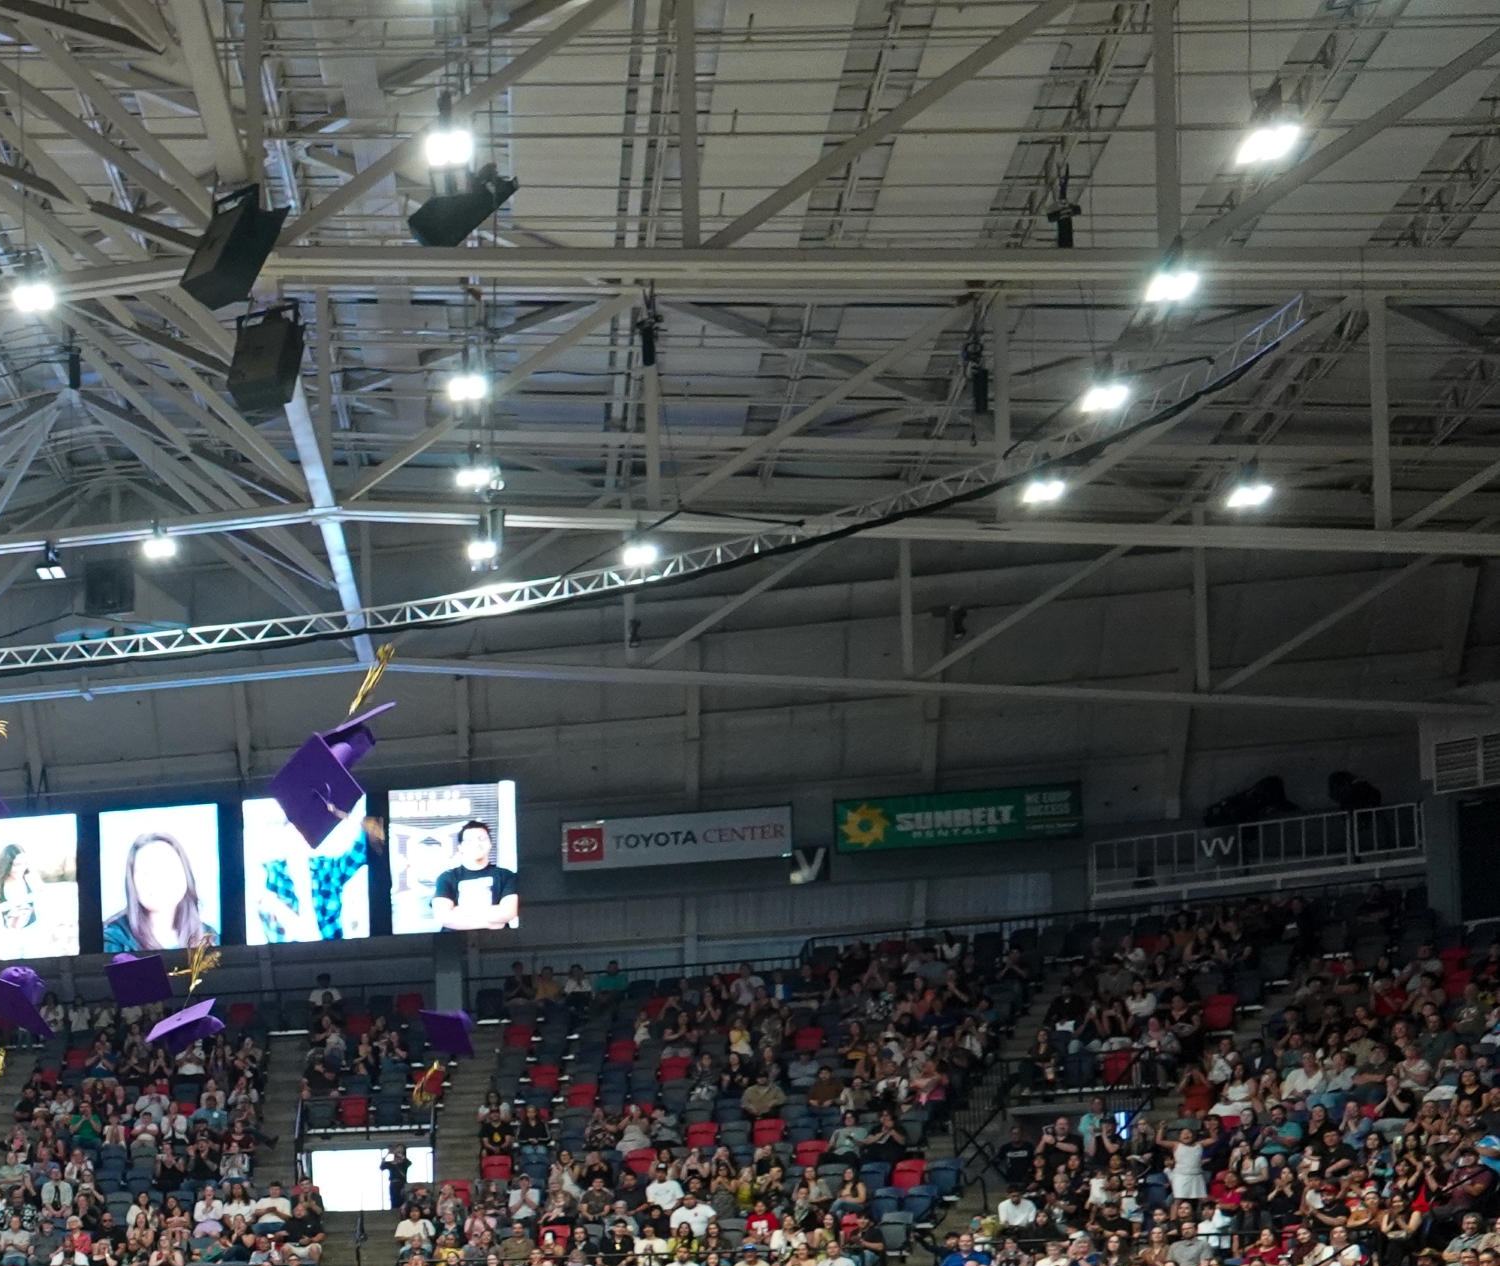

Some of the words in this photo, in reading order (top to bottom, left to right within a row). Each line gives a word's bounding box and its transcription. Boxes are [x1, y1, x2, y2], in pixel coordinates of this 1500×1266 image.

[895, 805, 1015, 833] SUNBELT
[613, 831, 698, 851] TOYOTA
[702, 823, 785, 845] CENTER
